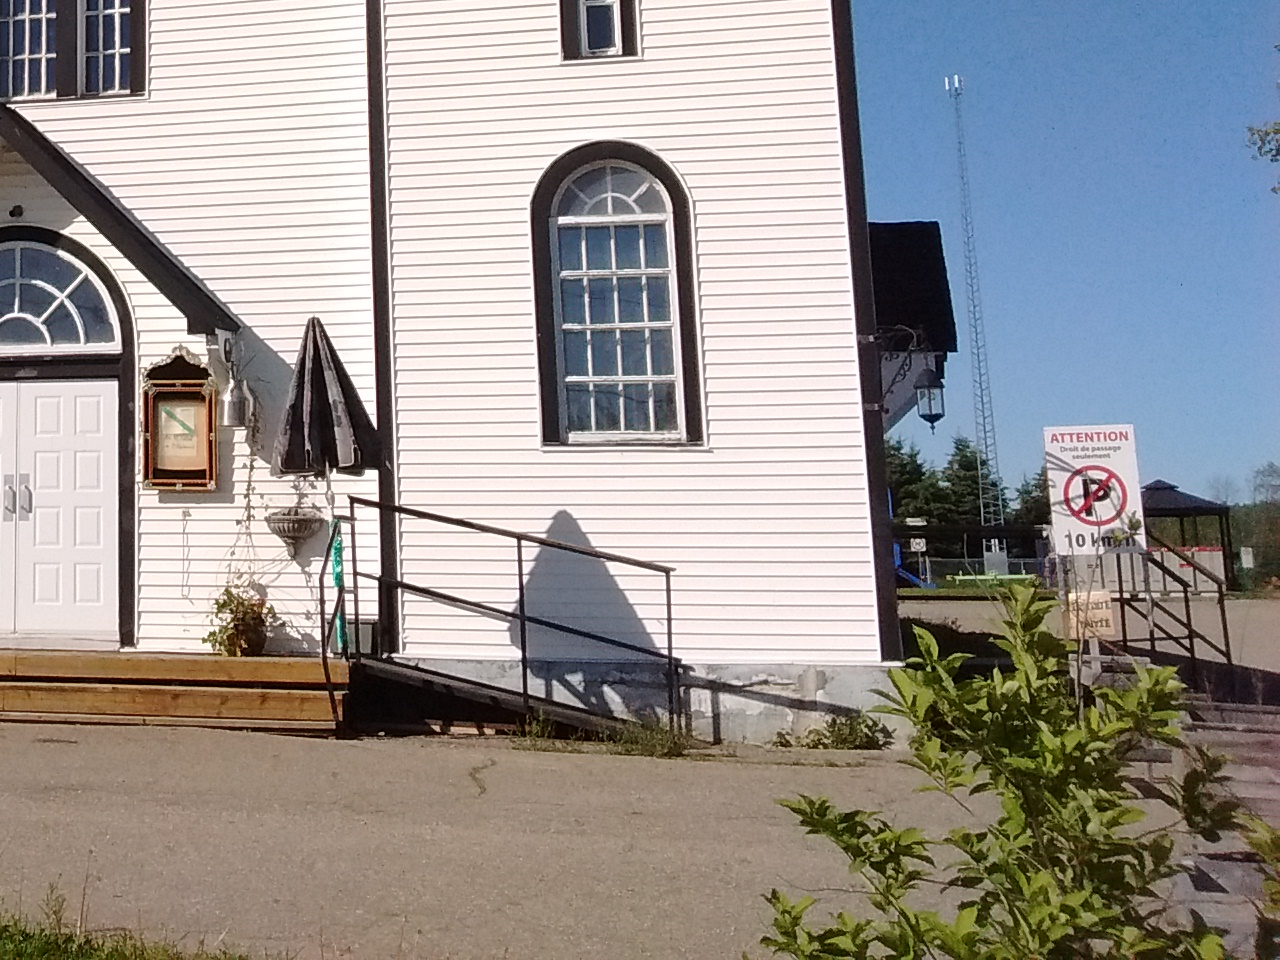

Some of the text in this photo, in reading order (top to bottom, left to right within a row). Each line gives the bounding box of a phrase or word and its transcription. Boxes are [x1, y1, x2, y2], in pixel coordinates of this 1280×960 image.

[1050, 430, 1130, 444] ATTENTION
[1091, 445, 1122, 453] passage
[1072, 452, 1111, 460] seulement
[1064, 531, 1136, 548] 10 kmh
